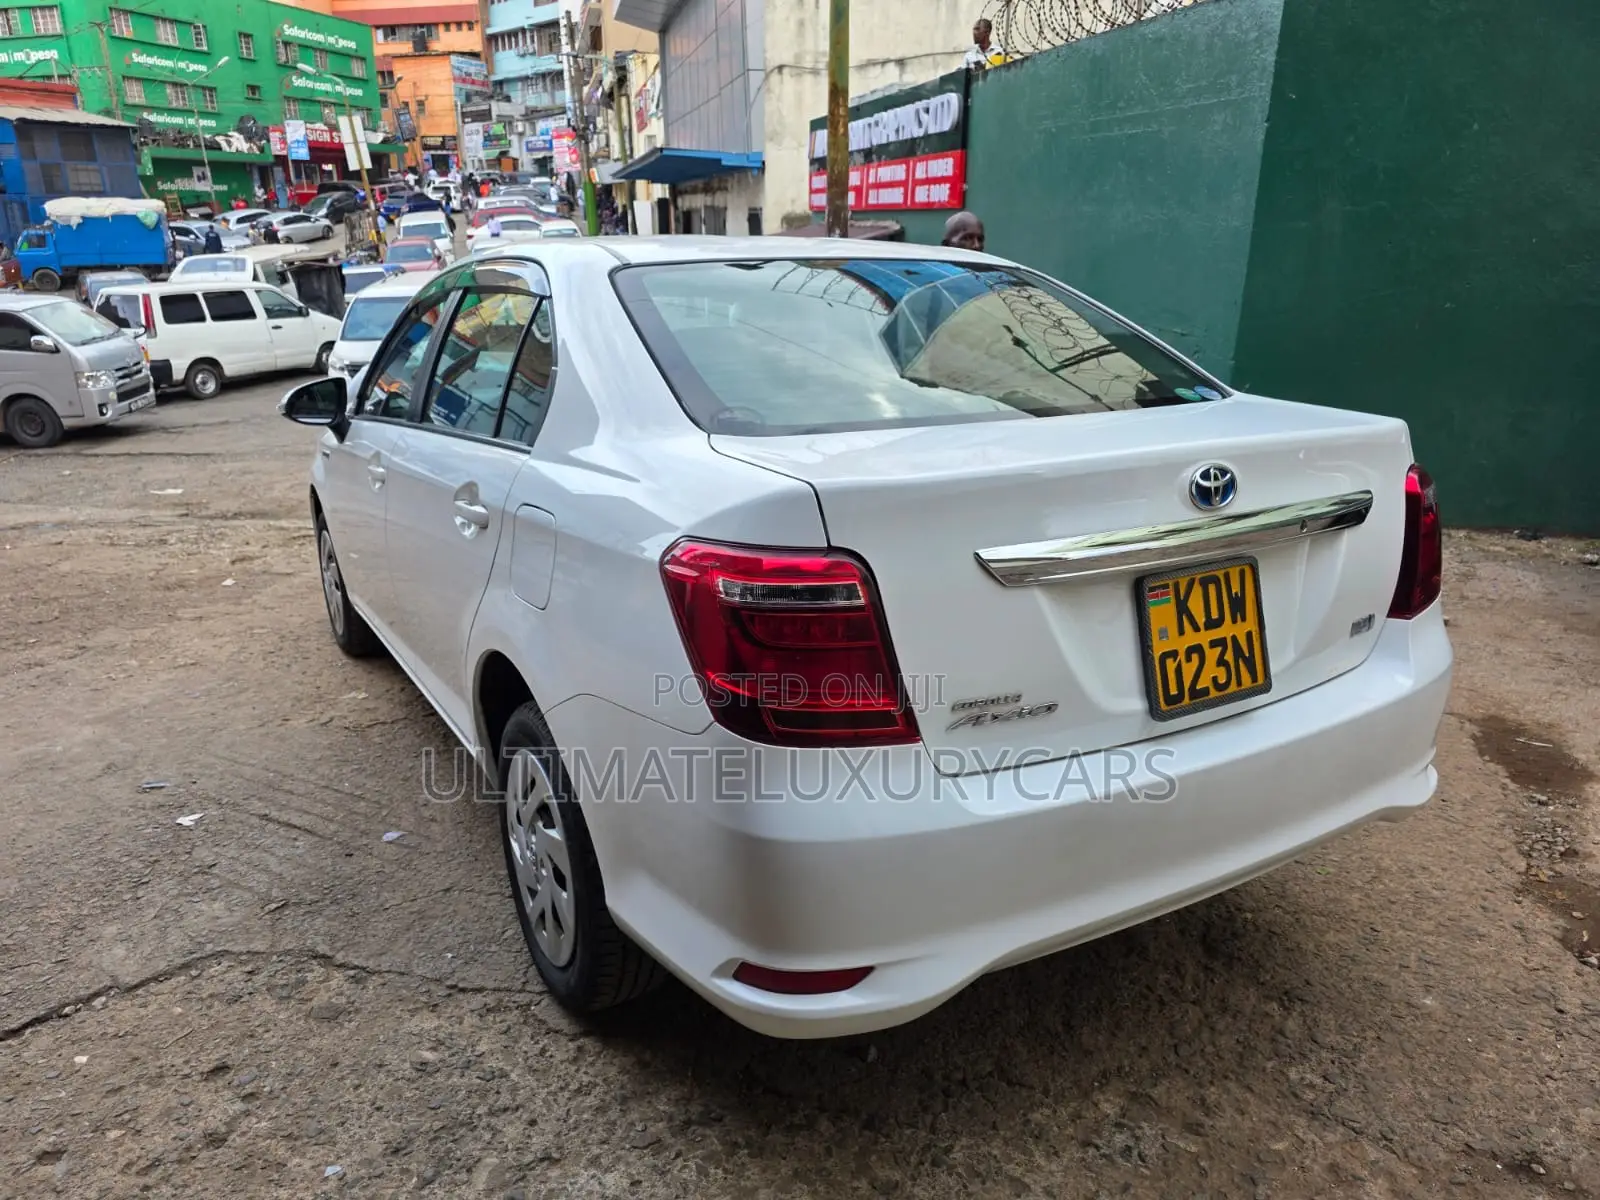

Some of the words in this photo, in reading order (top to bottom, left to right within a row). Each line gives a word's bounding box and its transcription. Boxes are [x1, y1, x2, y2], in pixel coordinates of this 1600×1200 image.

[283, 24, 325, 43] Safaricom
[131, 52, 175, 68] Safaricom
[291, 75, 333, 92] Safaricom
[142, 111, 184, 125] Safaricom
[306, 129, 331, 143] SIGN
[1173, 567, 1248, 637] KDW
[1158, 629, 1259, 707] 023N
